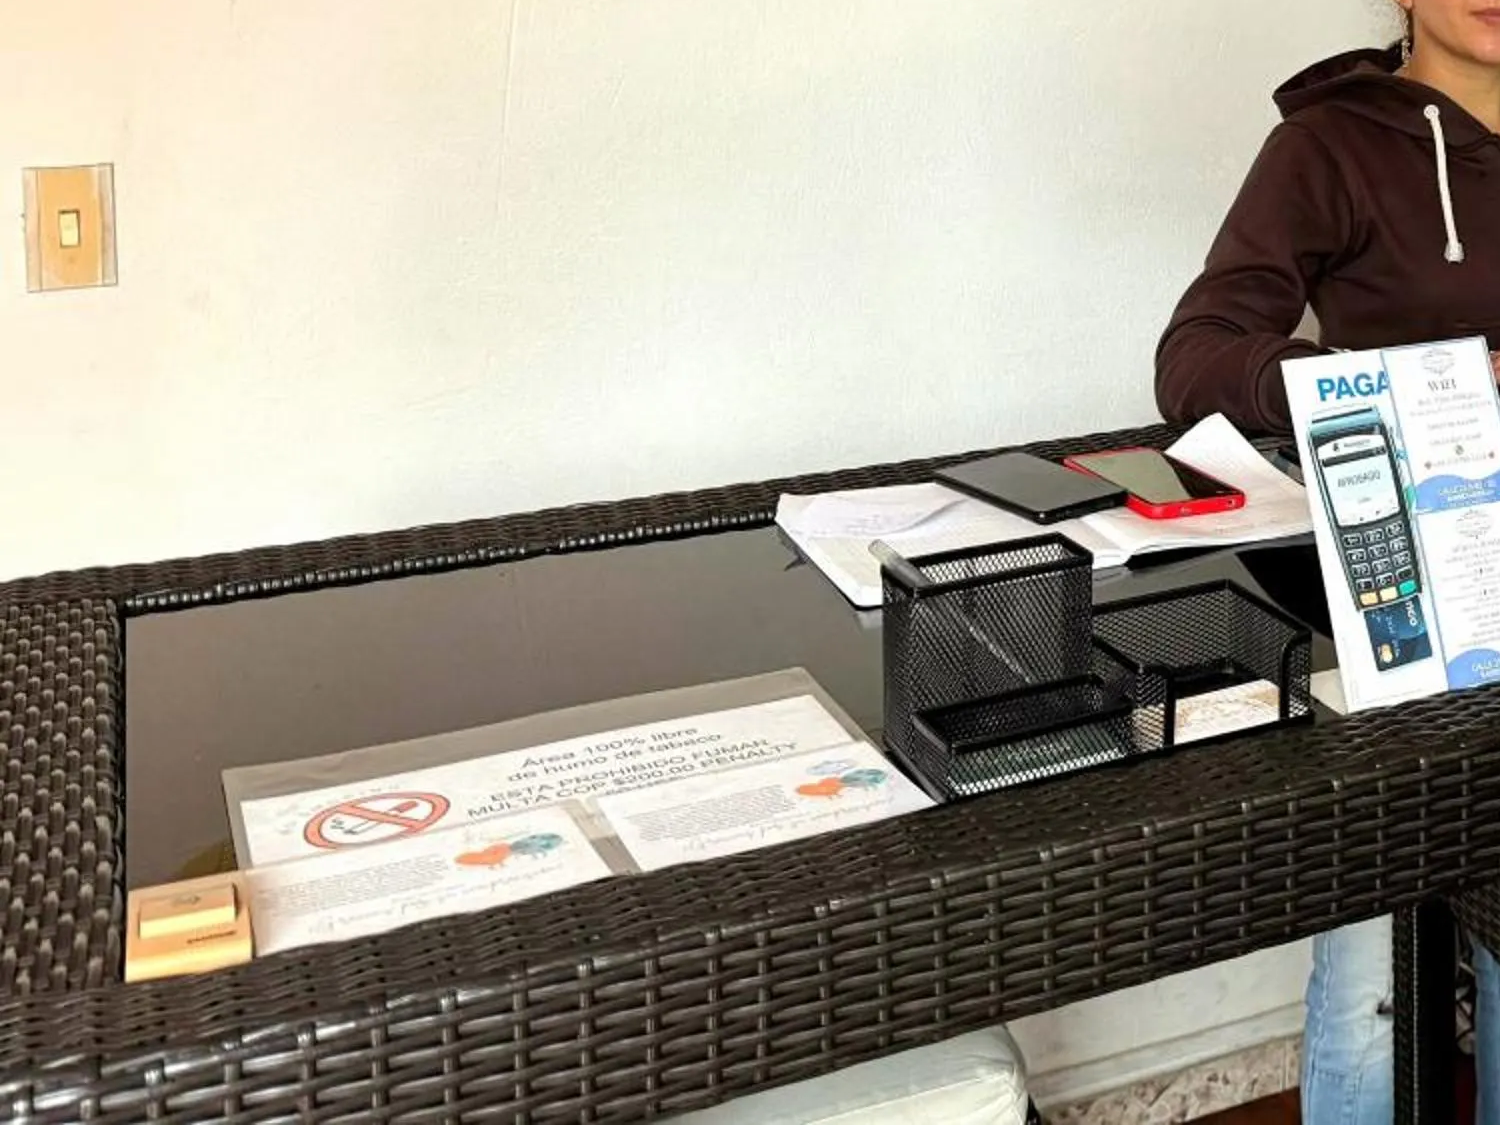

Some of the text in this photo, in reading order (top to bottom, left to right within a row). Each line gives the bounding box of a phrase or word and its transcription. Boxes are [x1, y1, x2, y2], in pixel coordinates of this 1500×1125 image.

[508, 732, 722, 783] de humo de tabaco
[559, 756, 686, 788] PROHIBIDO
[692, 738, 770, 761] FUMAR
[584, 736, 646, 755] 100%
[650, 727, 698, 742] libre
[467, 795, 551, 818] MULTA
[556, 780, 607, 799] COP
[700, 741, 798, 769] PENALTY
